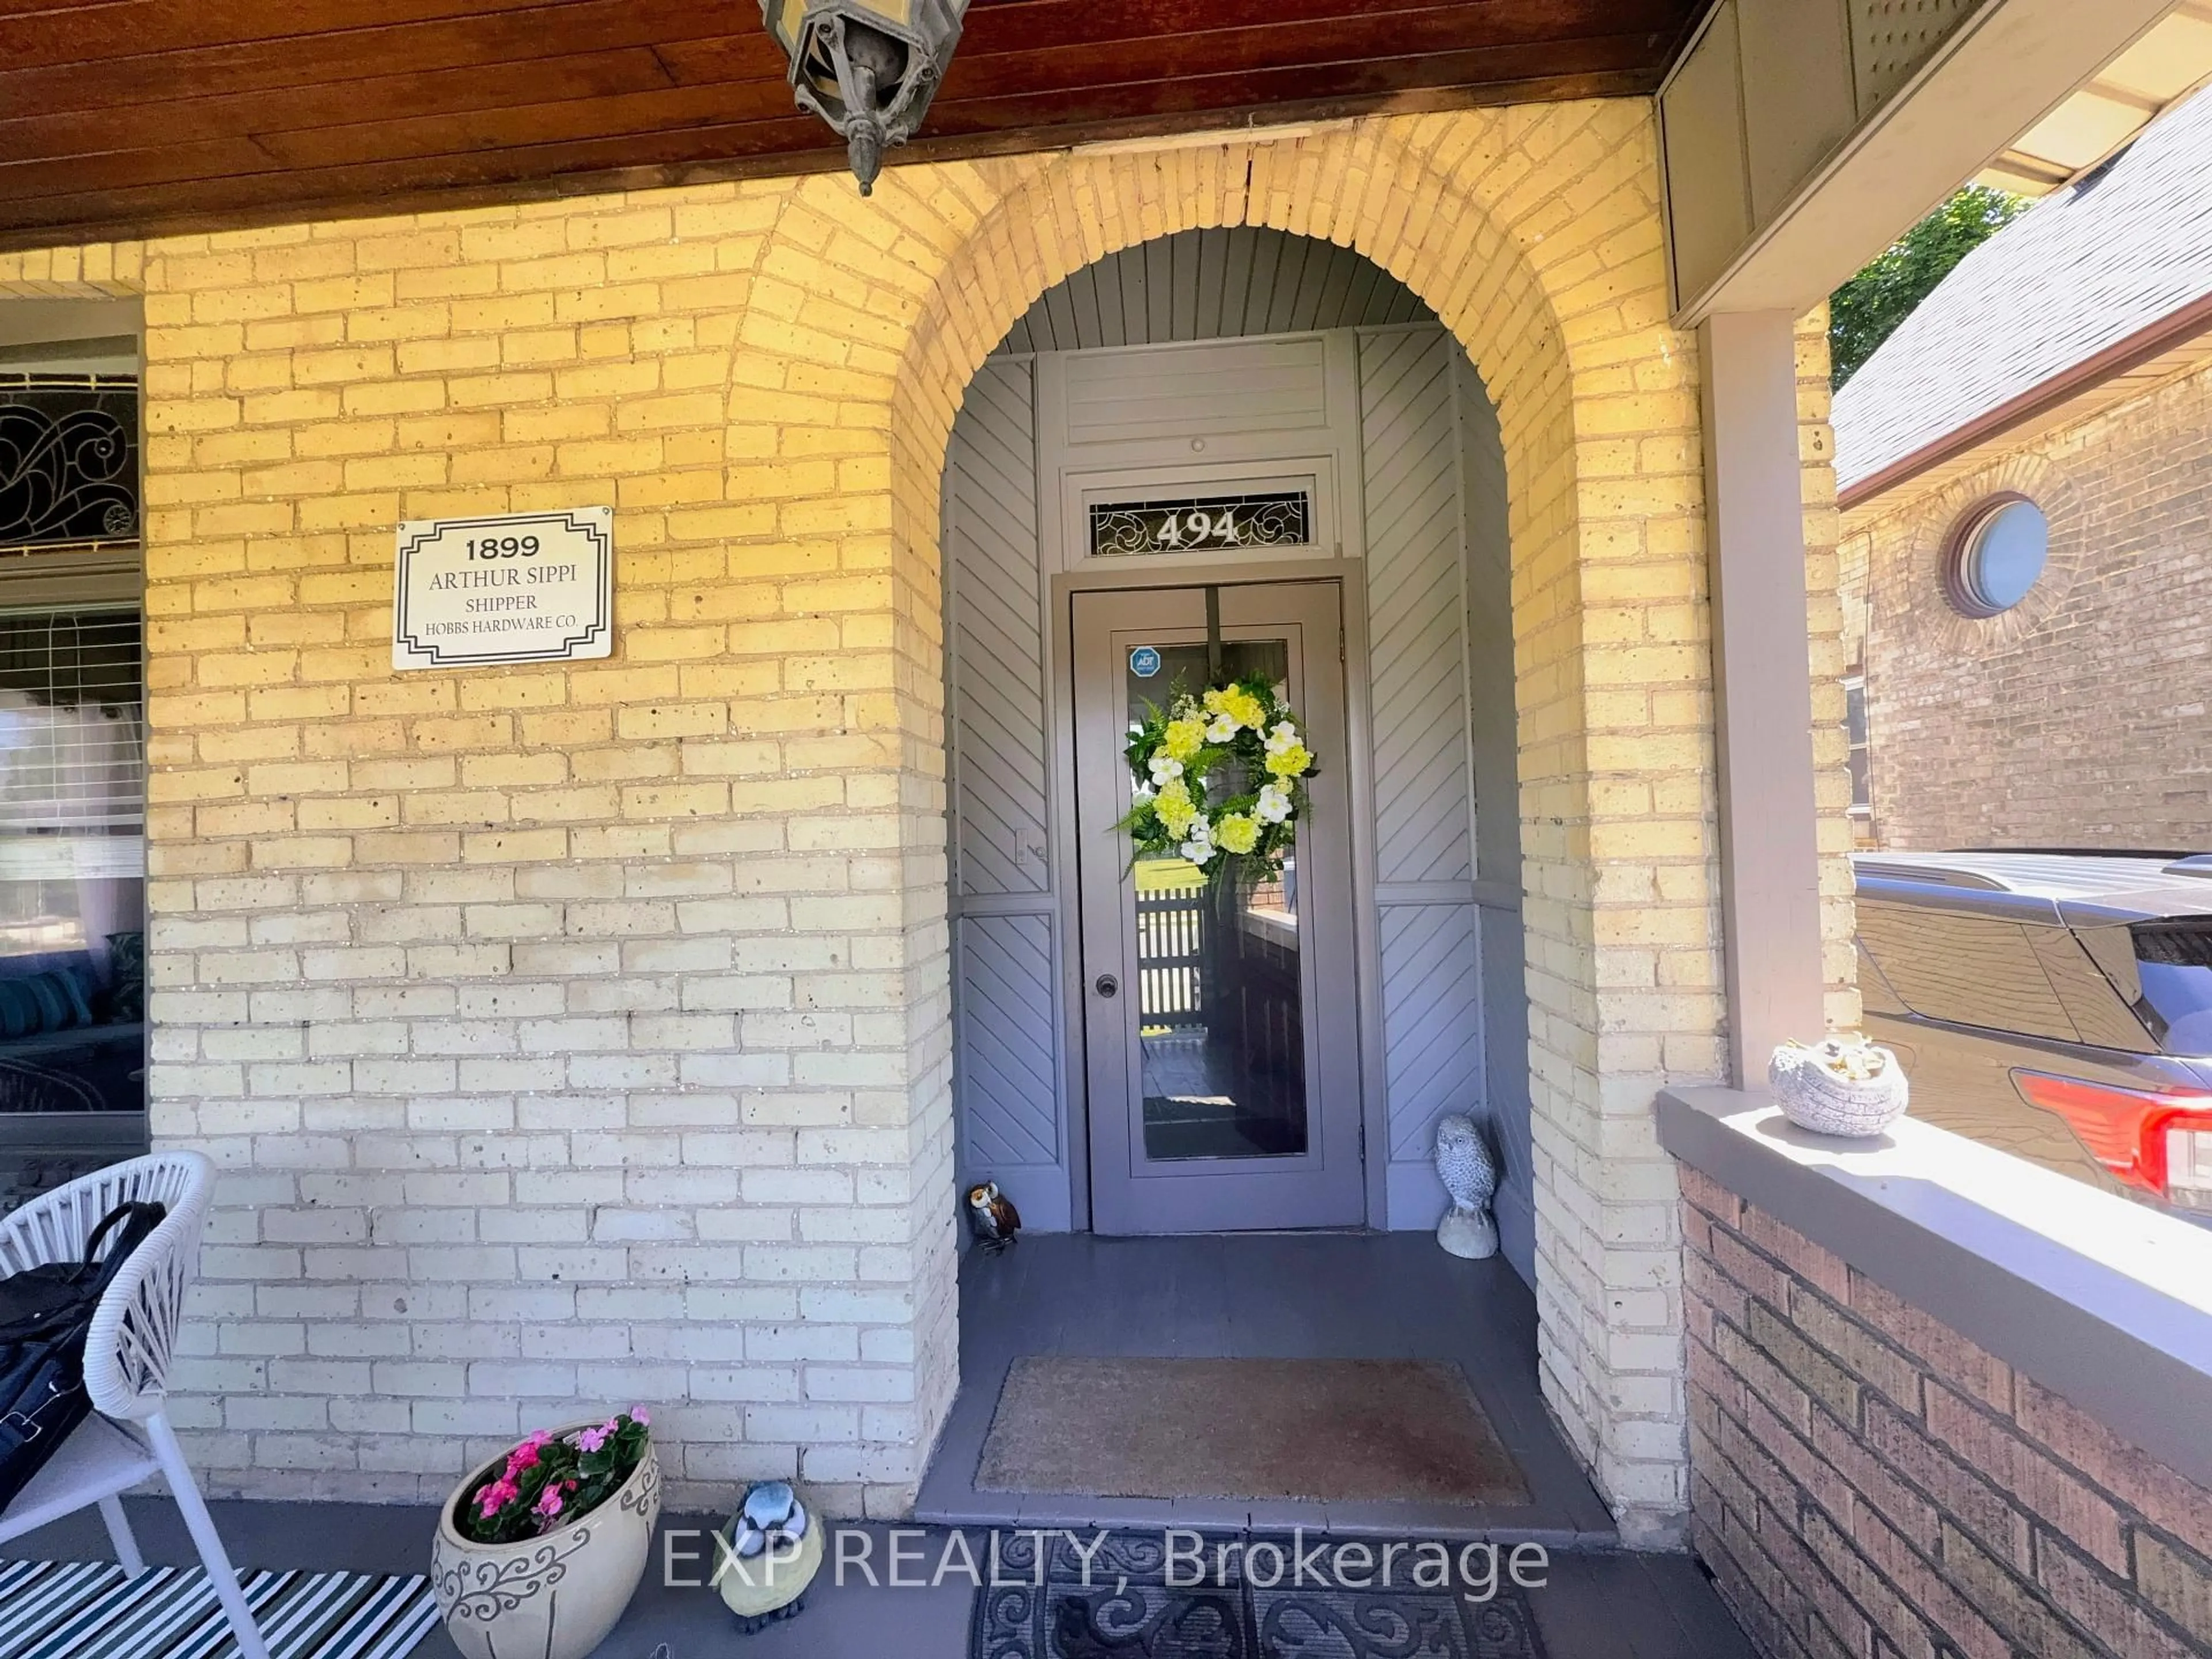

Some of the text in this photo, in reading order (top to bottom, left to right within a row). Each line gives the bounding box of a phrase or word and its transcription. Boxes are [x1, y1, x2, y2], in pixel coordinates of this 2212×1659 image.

[1157, 512, 1238, 550] 494
[467, 536, 540, 560] 1899
[429, 564, 577, 590] ARTHUR SIPPI
[465, 595, 537, 612] SHIPPER
[426, 615, 578, 635] HOBBS HARDWARE CO.
[1137, 656, 1154, 666] ADT
